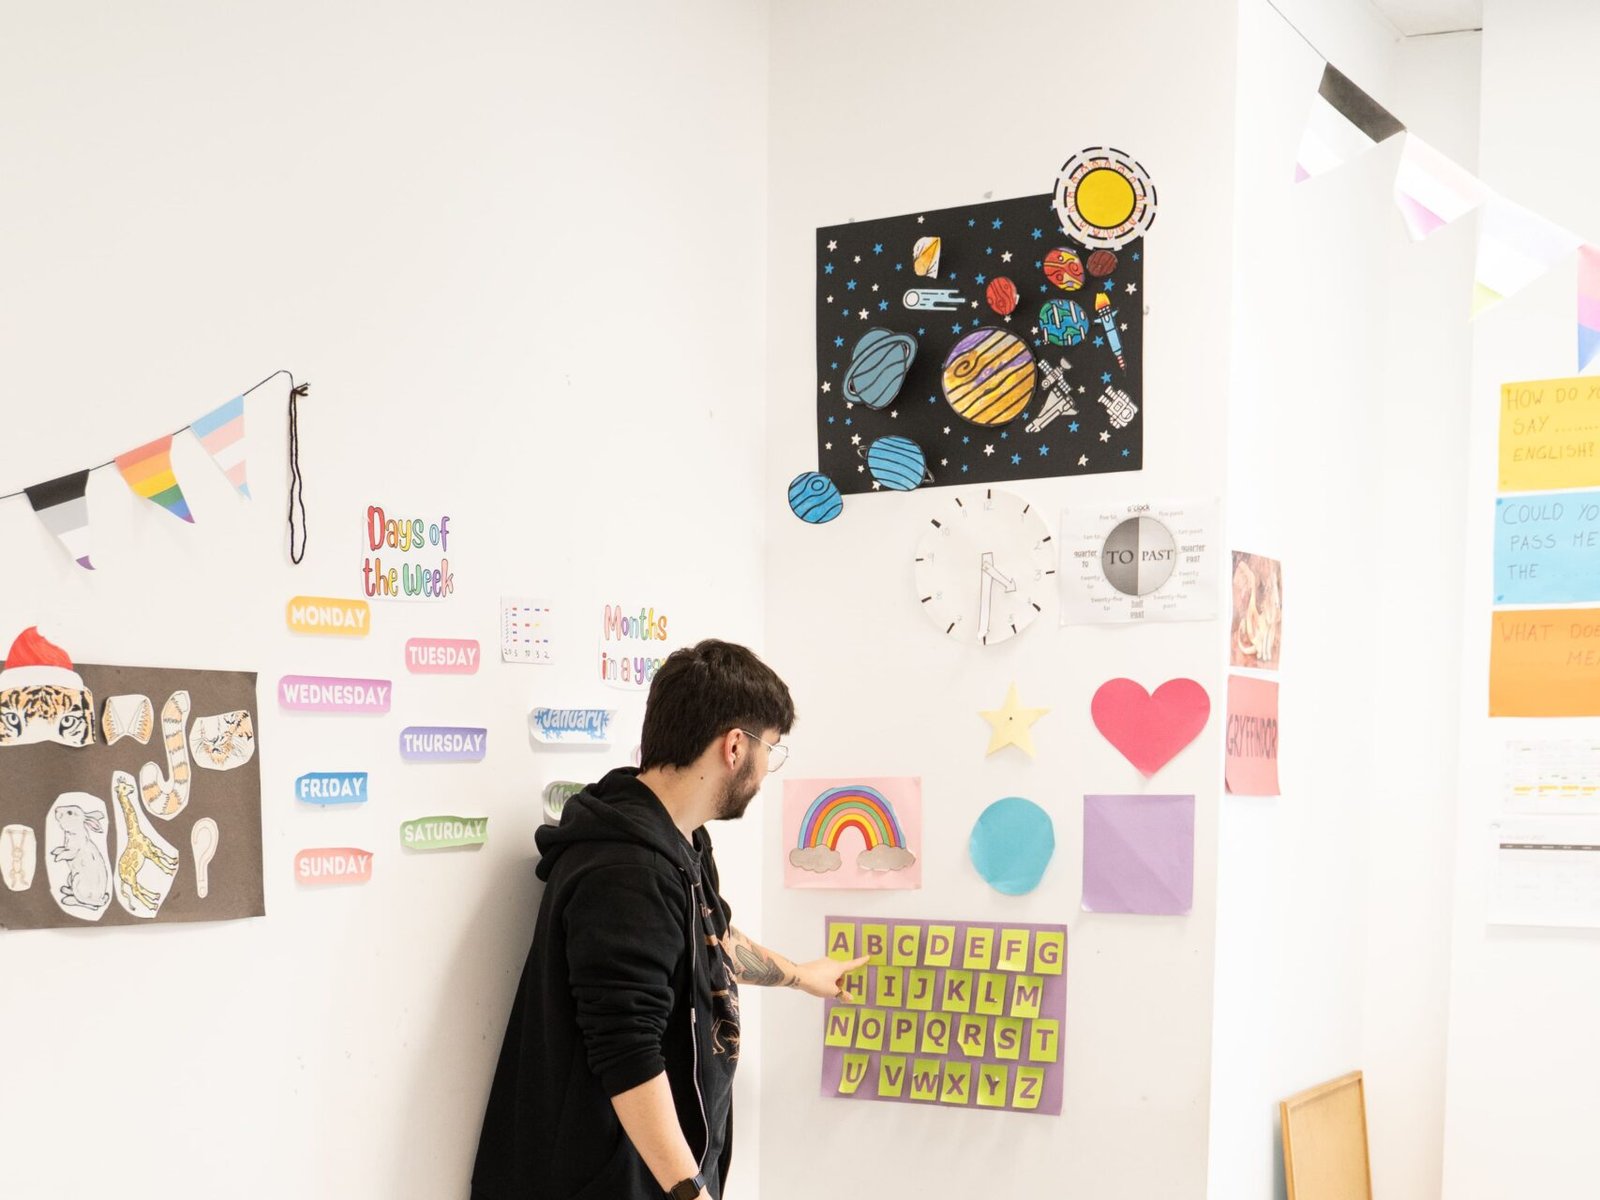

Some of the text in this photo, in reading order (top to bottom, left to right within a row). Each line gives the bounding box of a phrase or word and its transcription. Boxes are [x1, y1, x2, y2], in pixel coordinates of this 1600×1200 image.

[1506, 388, 1544, 411] HOW
[1556, 387, 1578, 404] DO
[1512, 415, 1550, 436] SAY
[1512, 441, 1595, 462] ENGLISH?
[1503, 502, 1600, 525] COULD YO
[367, 505, 450, 552] Days of
[1511, 534, 1556, 552] PASS
[1106, 550, 1174, 565] TO PAST
[363, 557, 399, 597] the
[1507, 563, 1539, 580] THE
[291, 604, 366, 628] MONDAY
[604, 604, 668, 641] Months
[1500, 622, 1554, 643] WHAT
[410, 646, 478, 667] TUESDAY
[1566, 650, 1600, 667] ME
[602, 652, 666, 685] in a yea
[283, 683, 389, 705] WEDNESDAY
[542, 708, 603, 737] January
[404, 733, 484, 754] THURSDAY
[1226, 712, 1278, 760] GRYFFINDOR
[300, 777, 364, 798] FRIDAY
[404, 821, 484, 843] SATURDAY
[299, 855, 369, 877] SUNDAY
[832, 931, 1058, 964] A B C D E F G
[846, 974, 1039, 1007] H I J K L M
[830, 1016, 1053, 1051] N O P Q R S T
[845, 1062, 1037, 1099] U V W X Y Z
